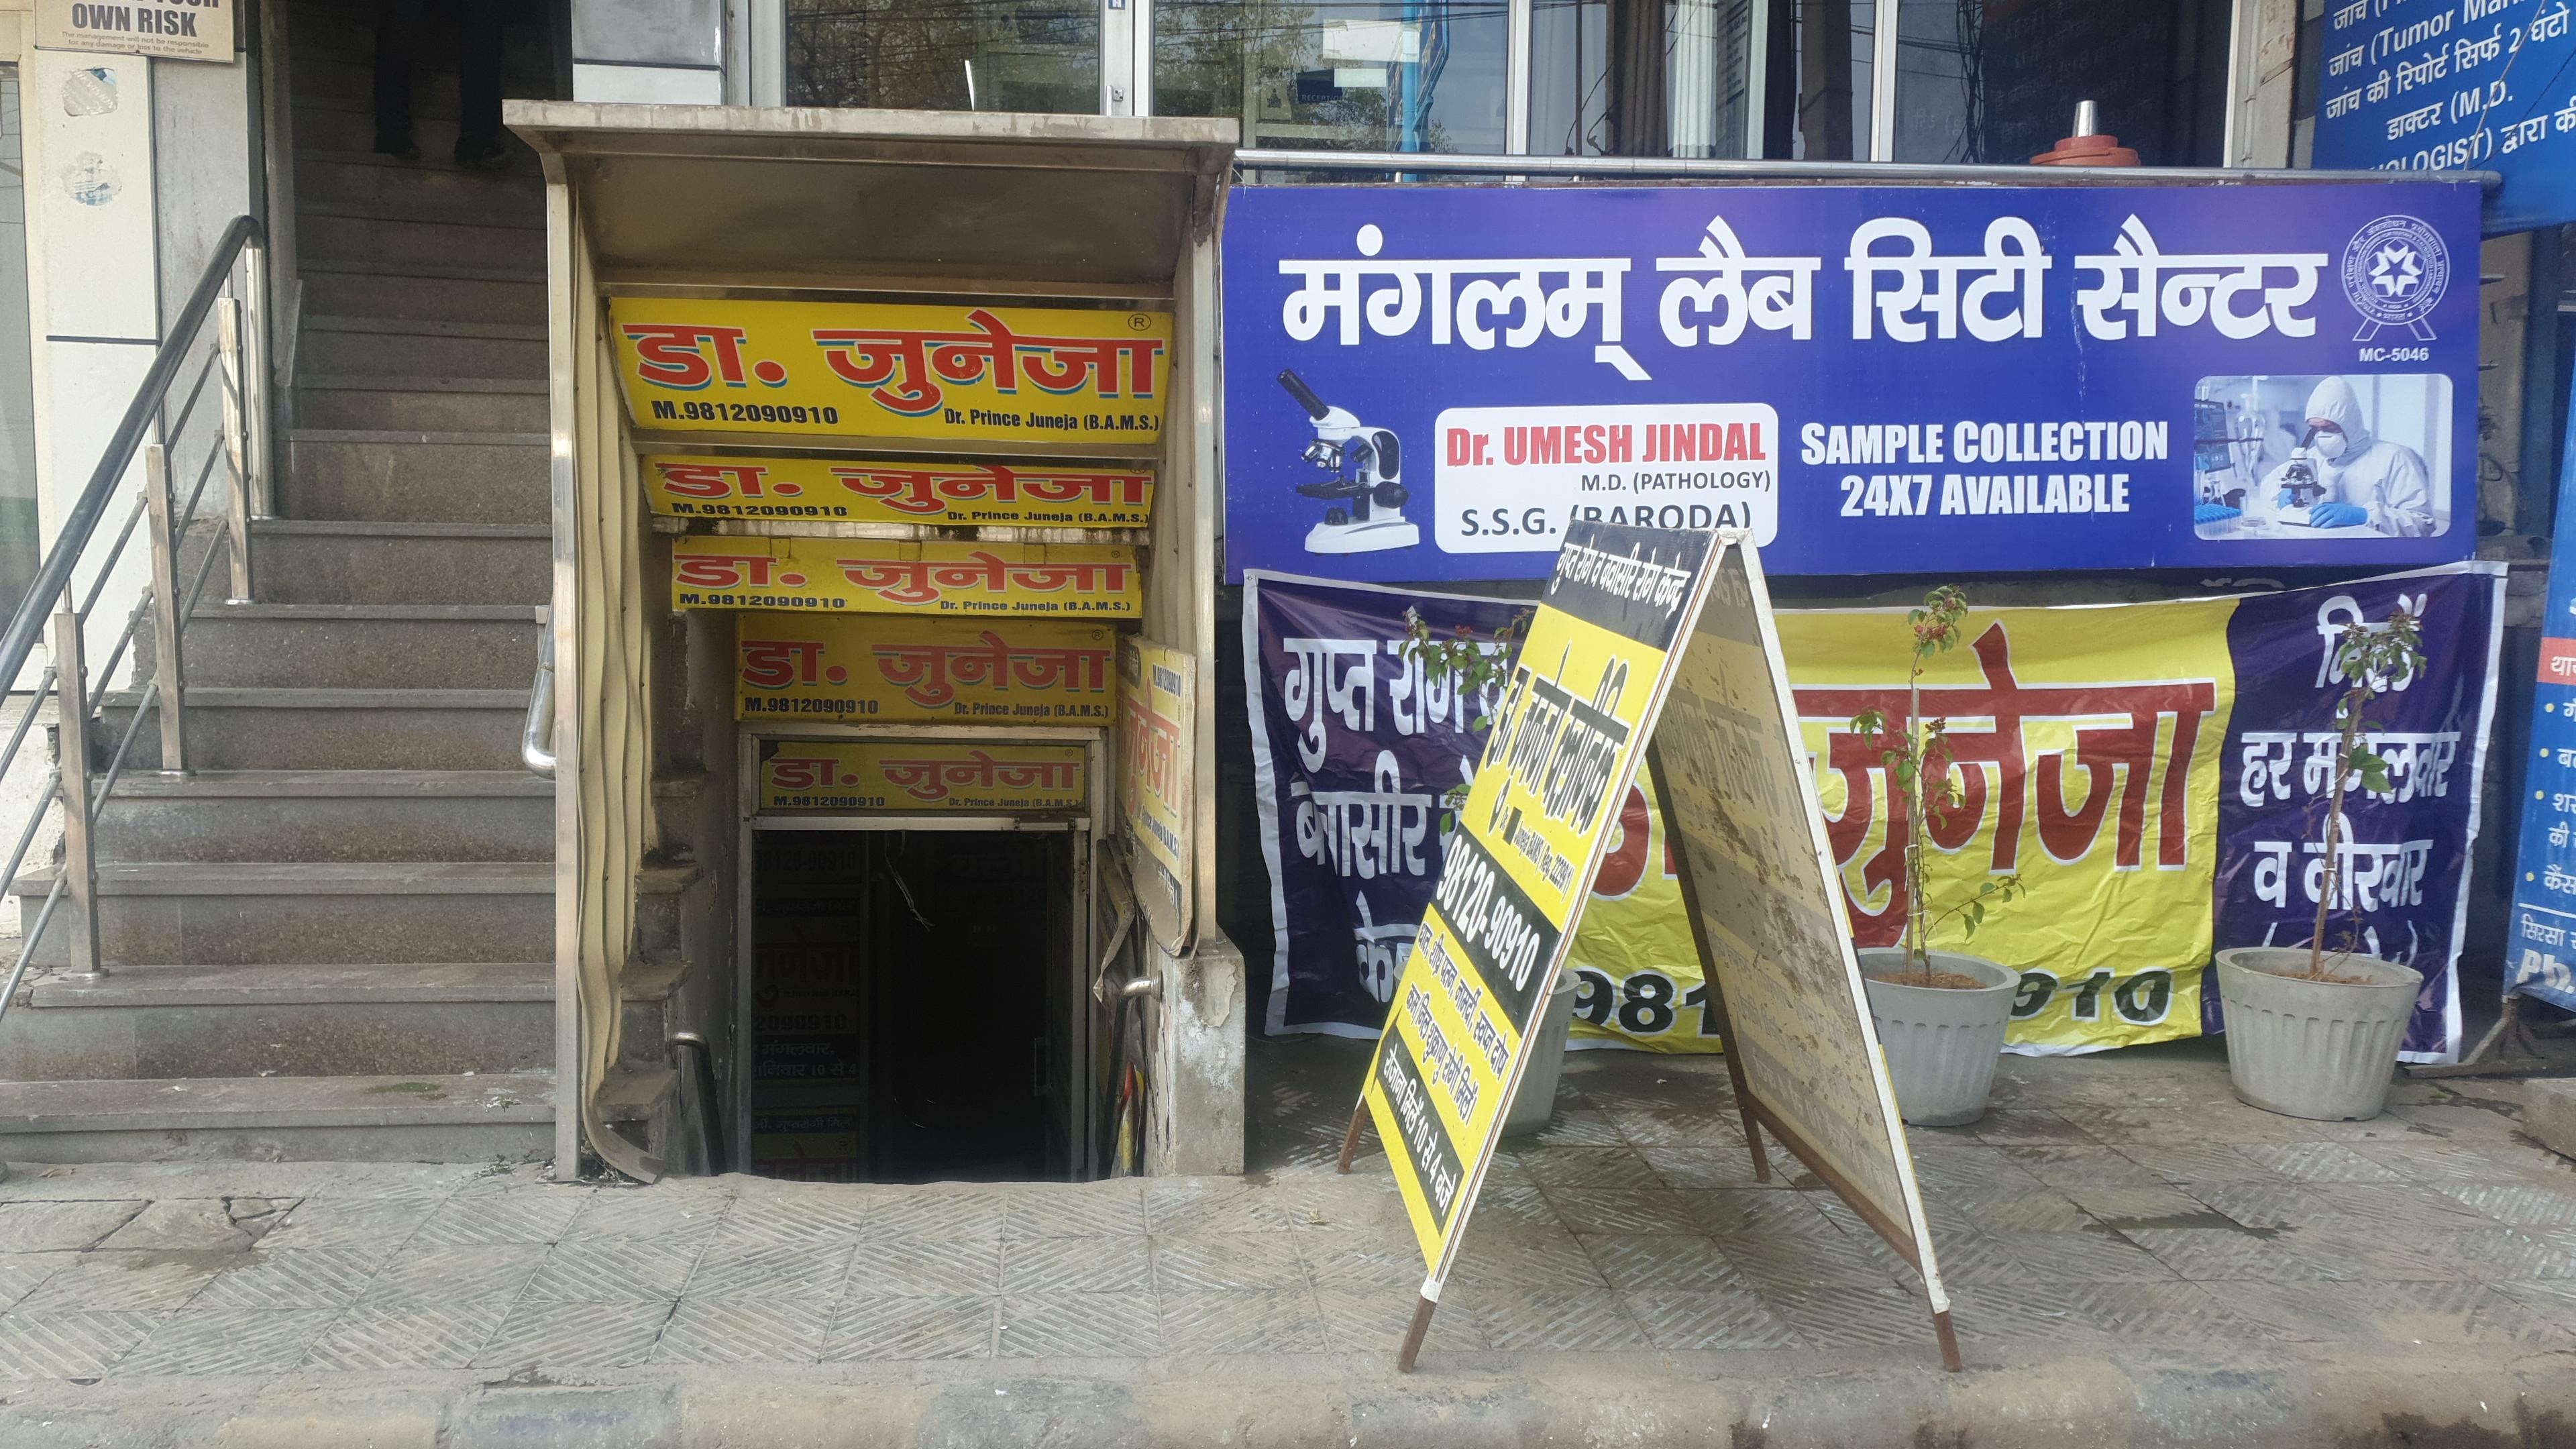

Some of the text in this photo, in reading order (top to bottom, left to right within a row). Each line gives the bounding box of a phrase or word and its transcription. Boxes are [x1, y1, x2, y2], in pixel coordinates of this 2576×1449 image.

[72, 3, 197, 37] OWN RISK
[76, 32, 125, 42] management
[167, 40, 209, 48] responsible
[2328, 44, 2364, 76] जांच
[2371, 9, 2454, 65] (Tumor
[95, 40, 125, 50] damage
[2326, 87, 2361, 119] जांच
[2367, 70, 2390, 103] की
[2396, 44, 2449, 95] रिपोर्ट
[2454, 23, 2502, 73] सिर्फ
[2508, 28, 2520, 54] 2
[2451, 80, 2513, 123] (M.D.
[1279, 224, 1652, 380] मंगलम्
[1656, 215, 1821, 347] लैब
[1844, 214, 2051, 343] सिटी
[2074, 213, 2328, 339] सैन्टर
[621, 308, 1165, 417] डा. जुनेजा
[2359, 347, 2430, 362] MC-5046
[651, 400, 839, 425] M.9812090910
[944, 408, 1160, 433] Dr. Prince Juneja (B.A.M.S.)
[1446, 422, 1766, 467] Dr. UMESH JINDAL
[1801, 422, 1949, 466] SAMPLE
[1953, 420, 2169, 464] COLLECTION
[654, 463, 1154, 515] डा. जुनेजा
[1581, 470, 1771, 495] M.D. (PATHOLOGY)
[1840, 472, 2130, 517] 24X7 AVAILABLE
[672, 501, 847, 518] M.9812090910
[947, 511, 1149, 525] Dr. Prince Juneja (B.A.M.S.)
[1460, 501, 1752, 537] S.S.G. (BARODA)
[674, 551, 1134, 606] डा. जुनेजा
[1574, 534, 1598, 584] रोग
[1591, 552, 1607, 587] व
[1632, 547, 1663, 604] रोग
[680, 593, 846, 609] M.9812090910
[941, 600, 1131, 614] Dr. Prince Juneja (B.A.M.S.)
[741, 640, 847, 689] डा.
[872, 630, 1112, 708] जुनेजा
[1283, 638, 1377, 773] गुप्त
[1387, 606, 1468, 735] रोग
[745, 696, 879, 714] M.9812090910
[955, 702, 1108, 718] Dr. Prince Juneja (B.A.M.S.)
[1485, 664, 1531, 771] डा.
[1487, 639, 1572, 836] जुनेजा
[771, 750, 1080, 802] डा. जुनेजा
[2240, 733, 2297, 807] हर
[773, 796, 885, 806] M.9812090910
[949, 798, 961, 806] Dr.
[964, 798, 995, 806] Prince
[998, 798, 1030, 808] Juneja
[2254, 812, 2434, 912] व वीरवार
[1436, 833, 1540, 993] 98120-90910
[2516, 948, 2575, 994] Ph.
[1412, 1119, 1430, 1154] 10
[1430, 1148, 1442, 1184] 4
